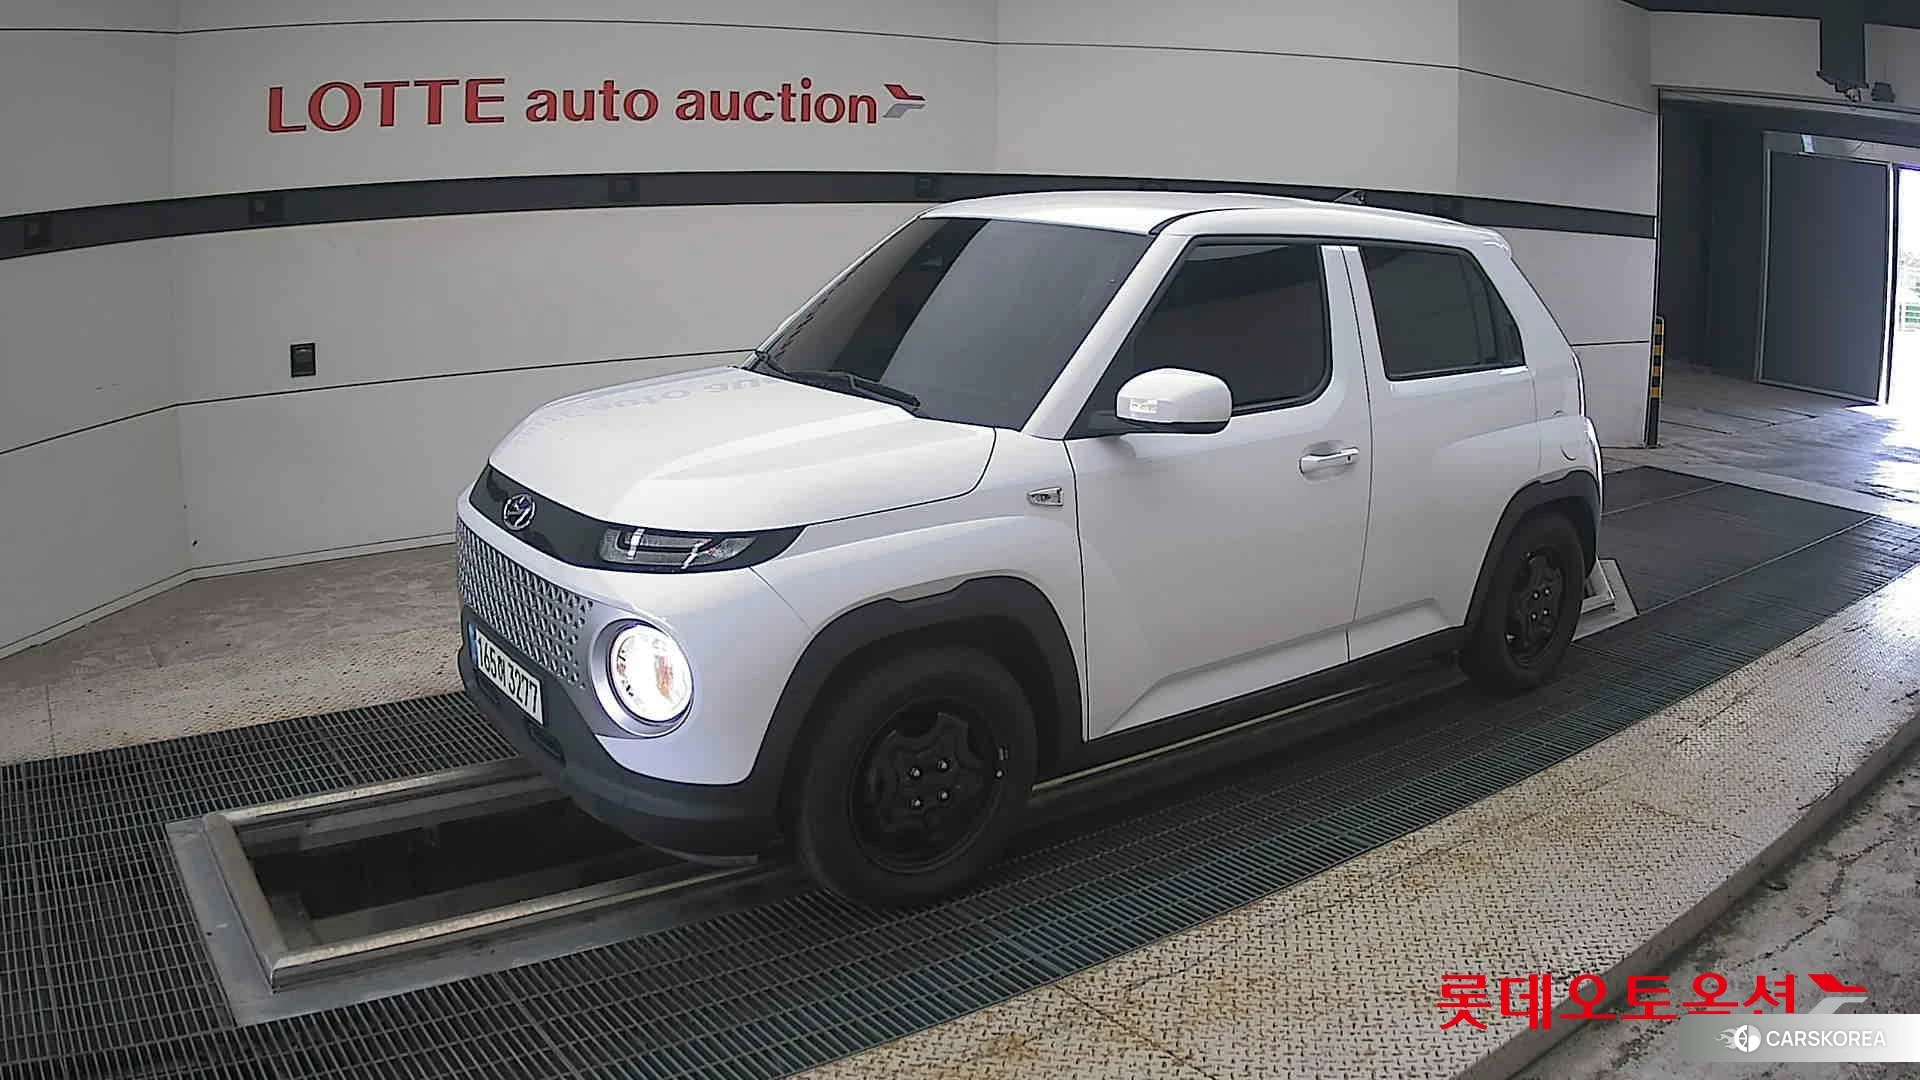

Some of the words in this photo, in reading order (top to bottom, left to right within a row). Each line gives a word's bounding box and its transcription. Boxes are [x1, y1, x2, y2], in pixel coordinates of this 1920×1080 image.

[268, 78, 505, 133] LOTTE
[525, 79, 659, 123] auto
[674, 77, 877, 124] auction
[507, 662, 538, 714] 3277
